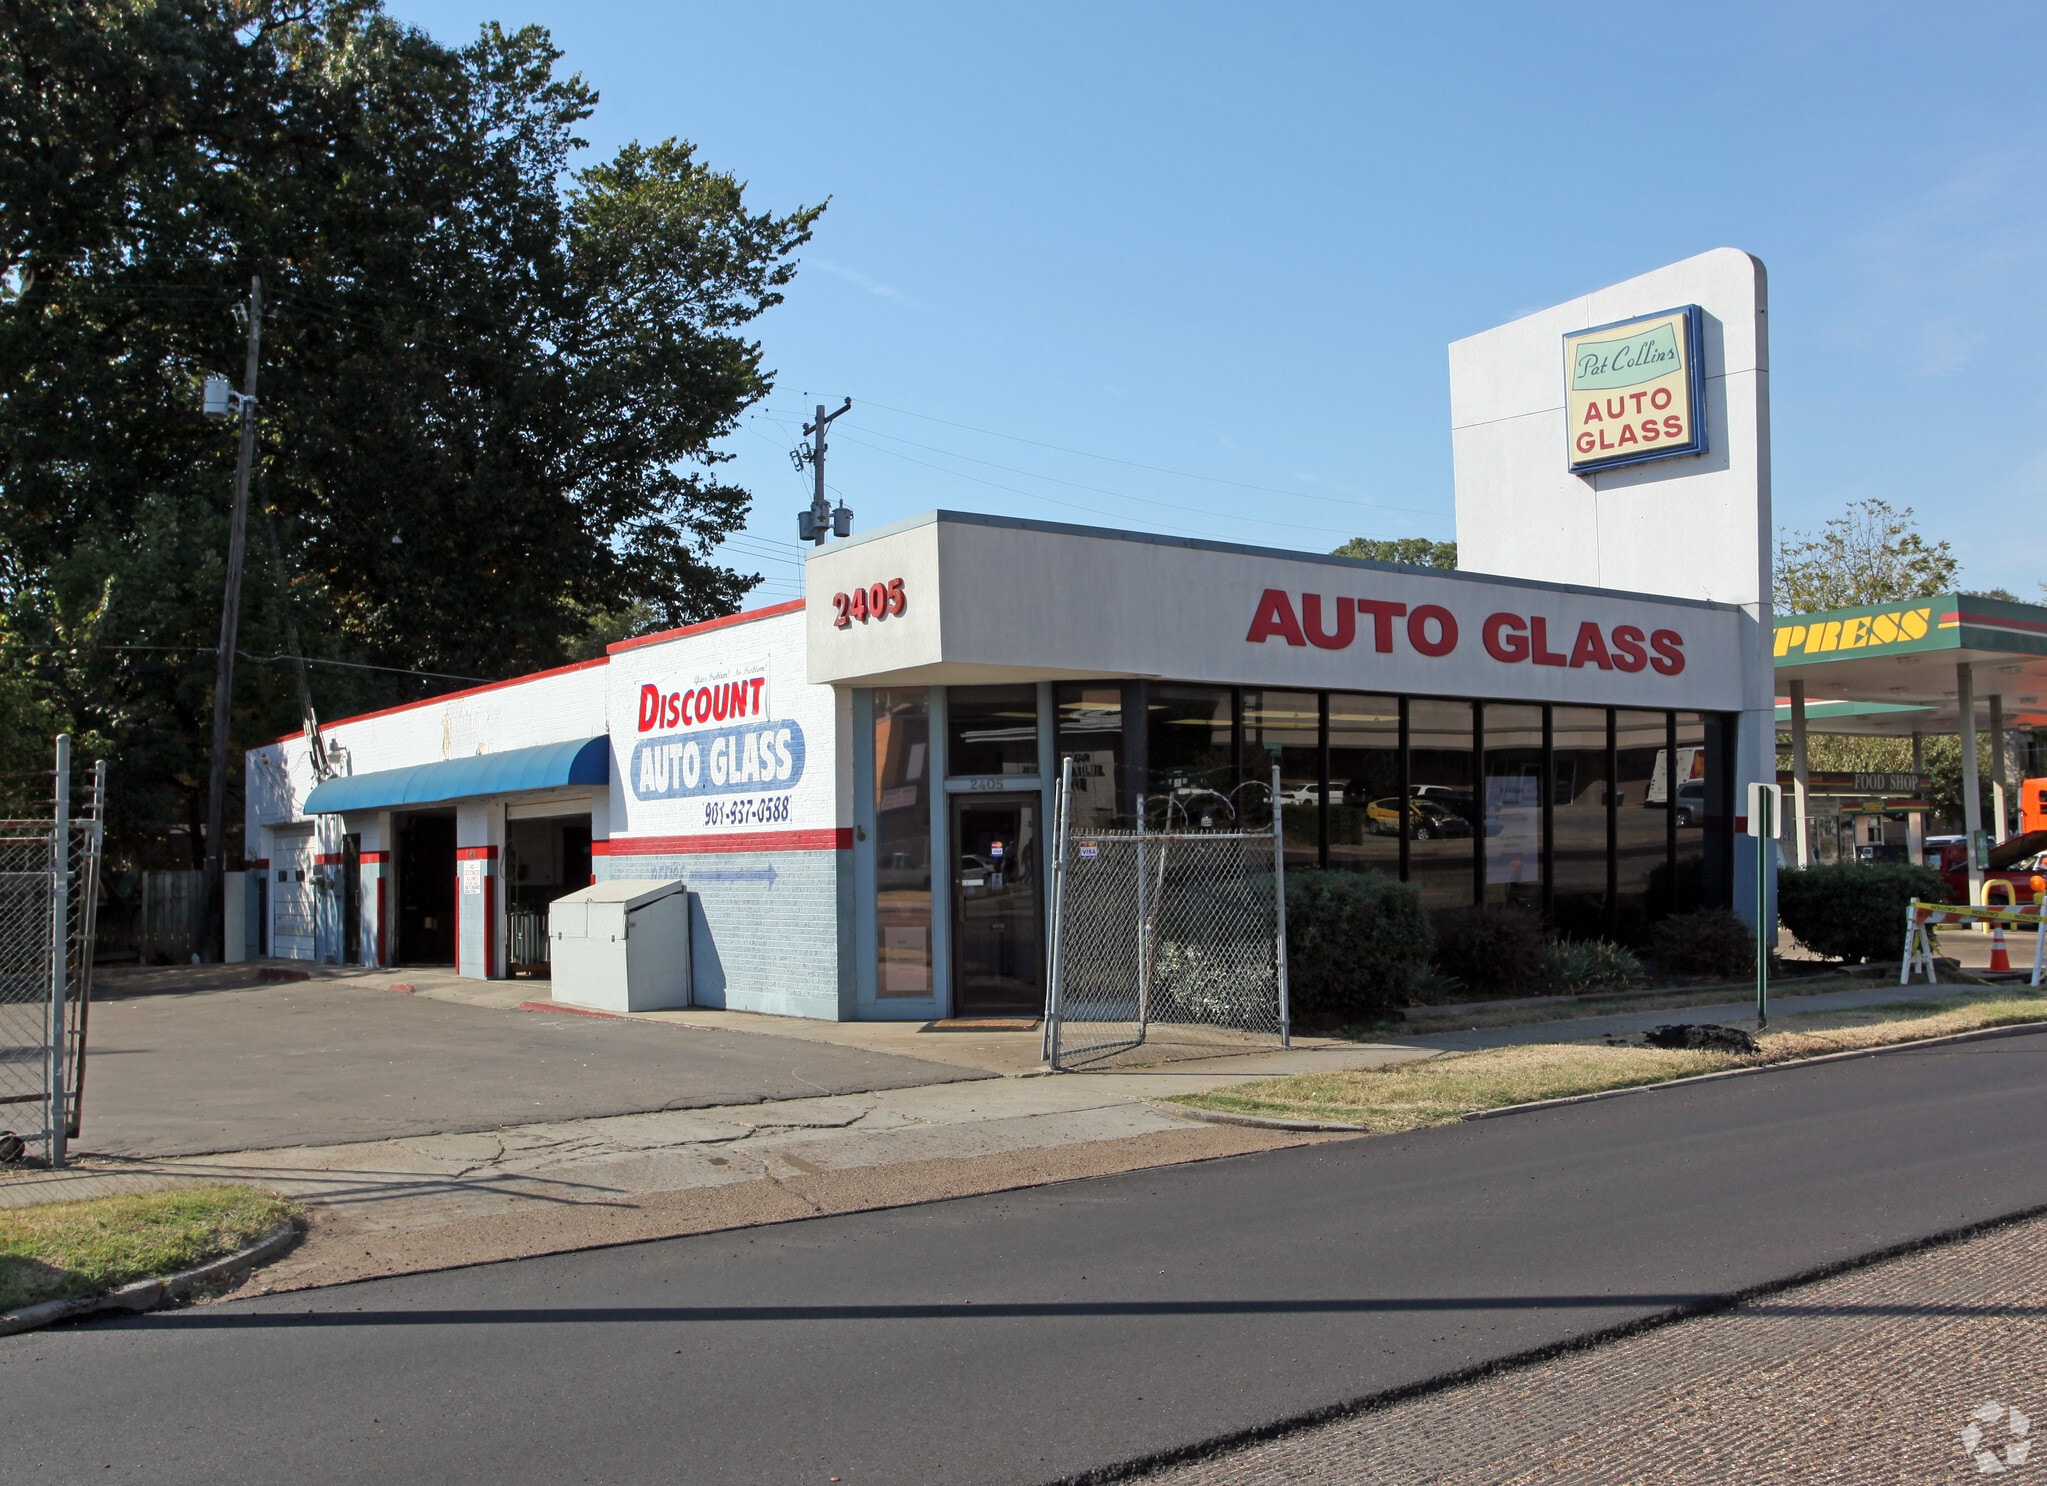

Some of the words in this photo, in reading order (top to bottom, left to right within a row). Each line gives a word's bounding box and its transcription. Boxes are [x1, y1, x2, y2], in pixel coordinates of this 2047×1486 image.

[1577, 353, 1608, 378] Pat
[1611, 340, 1676, 371] Collins
[1583, 387, 1672, 425] AUTO
[1576, 415, 1683, 453] GLASS
[832, 577, 906, 628] 2405
[1246, 588, 1459, 657] AUTO
[1482, 612, 1686, 676] GLASS
[1773, 608, 1931, 657] PRESS
[638, 677, 765, 732] DISCOUNT
[639, 741, 700, 794] AUTO
[709, 729, 793, 786] GLASS
[970, 778, 1004, 790] 2405
[1854, 774, 1885, 790] FOOD
[1889, 774, 1919, 790] SHOP
[705, 796, 789, 826] 901-937-0588
[1930, 904, 1957, 912] CAUTION
[1972, 909, 1999, 918] CAUTION
